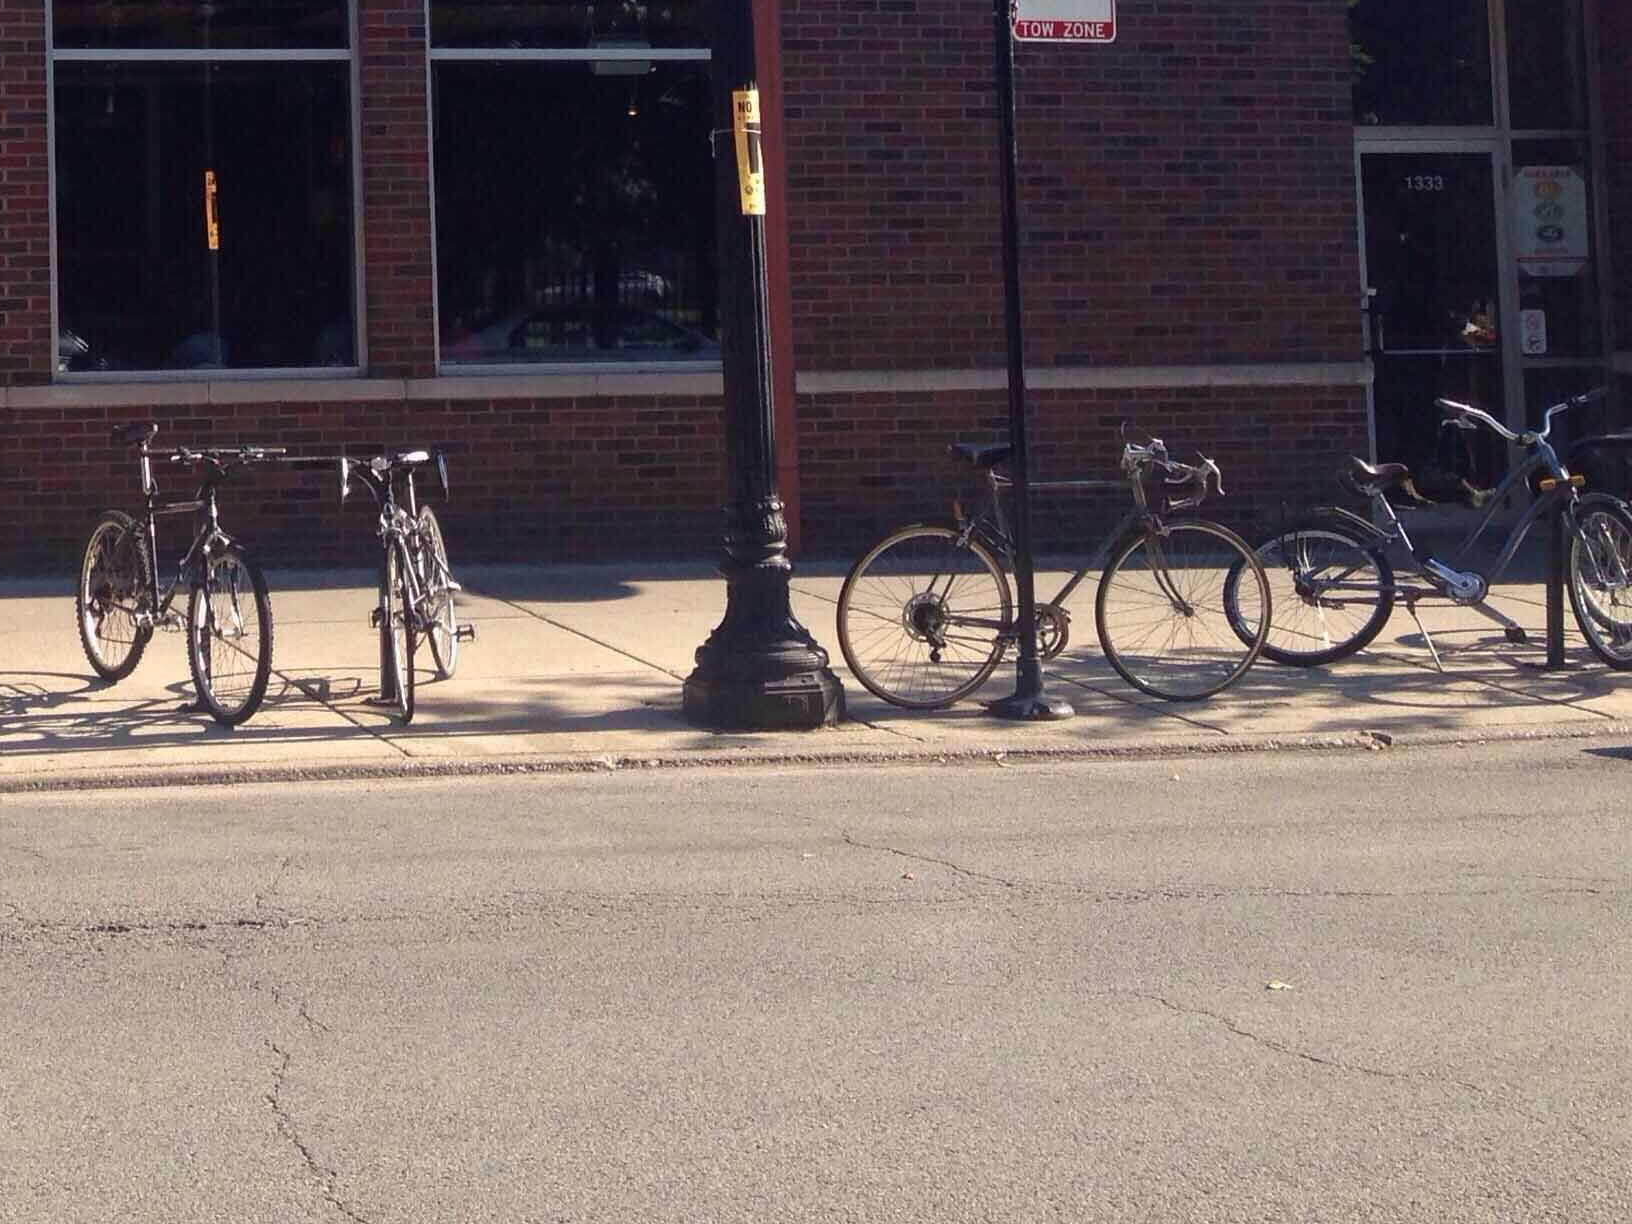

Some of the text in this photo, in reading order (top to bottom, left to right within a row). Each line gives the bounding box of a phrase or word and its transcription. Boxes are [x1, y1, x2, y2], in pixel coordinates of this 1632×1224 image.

[1021, 22, 1105, 38] TOW ZONE
[1404, 175, 1444, 191] 1333
